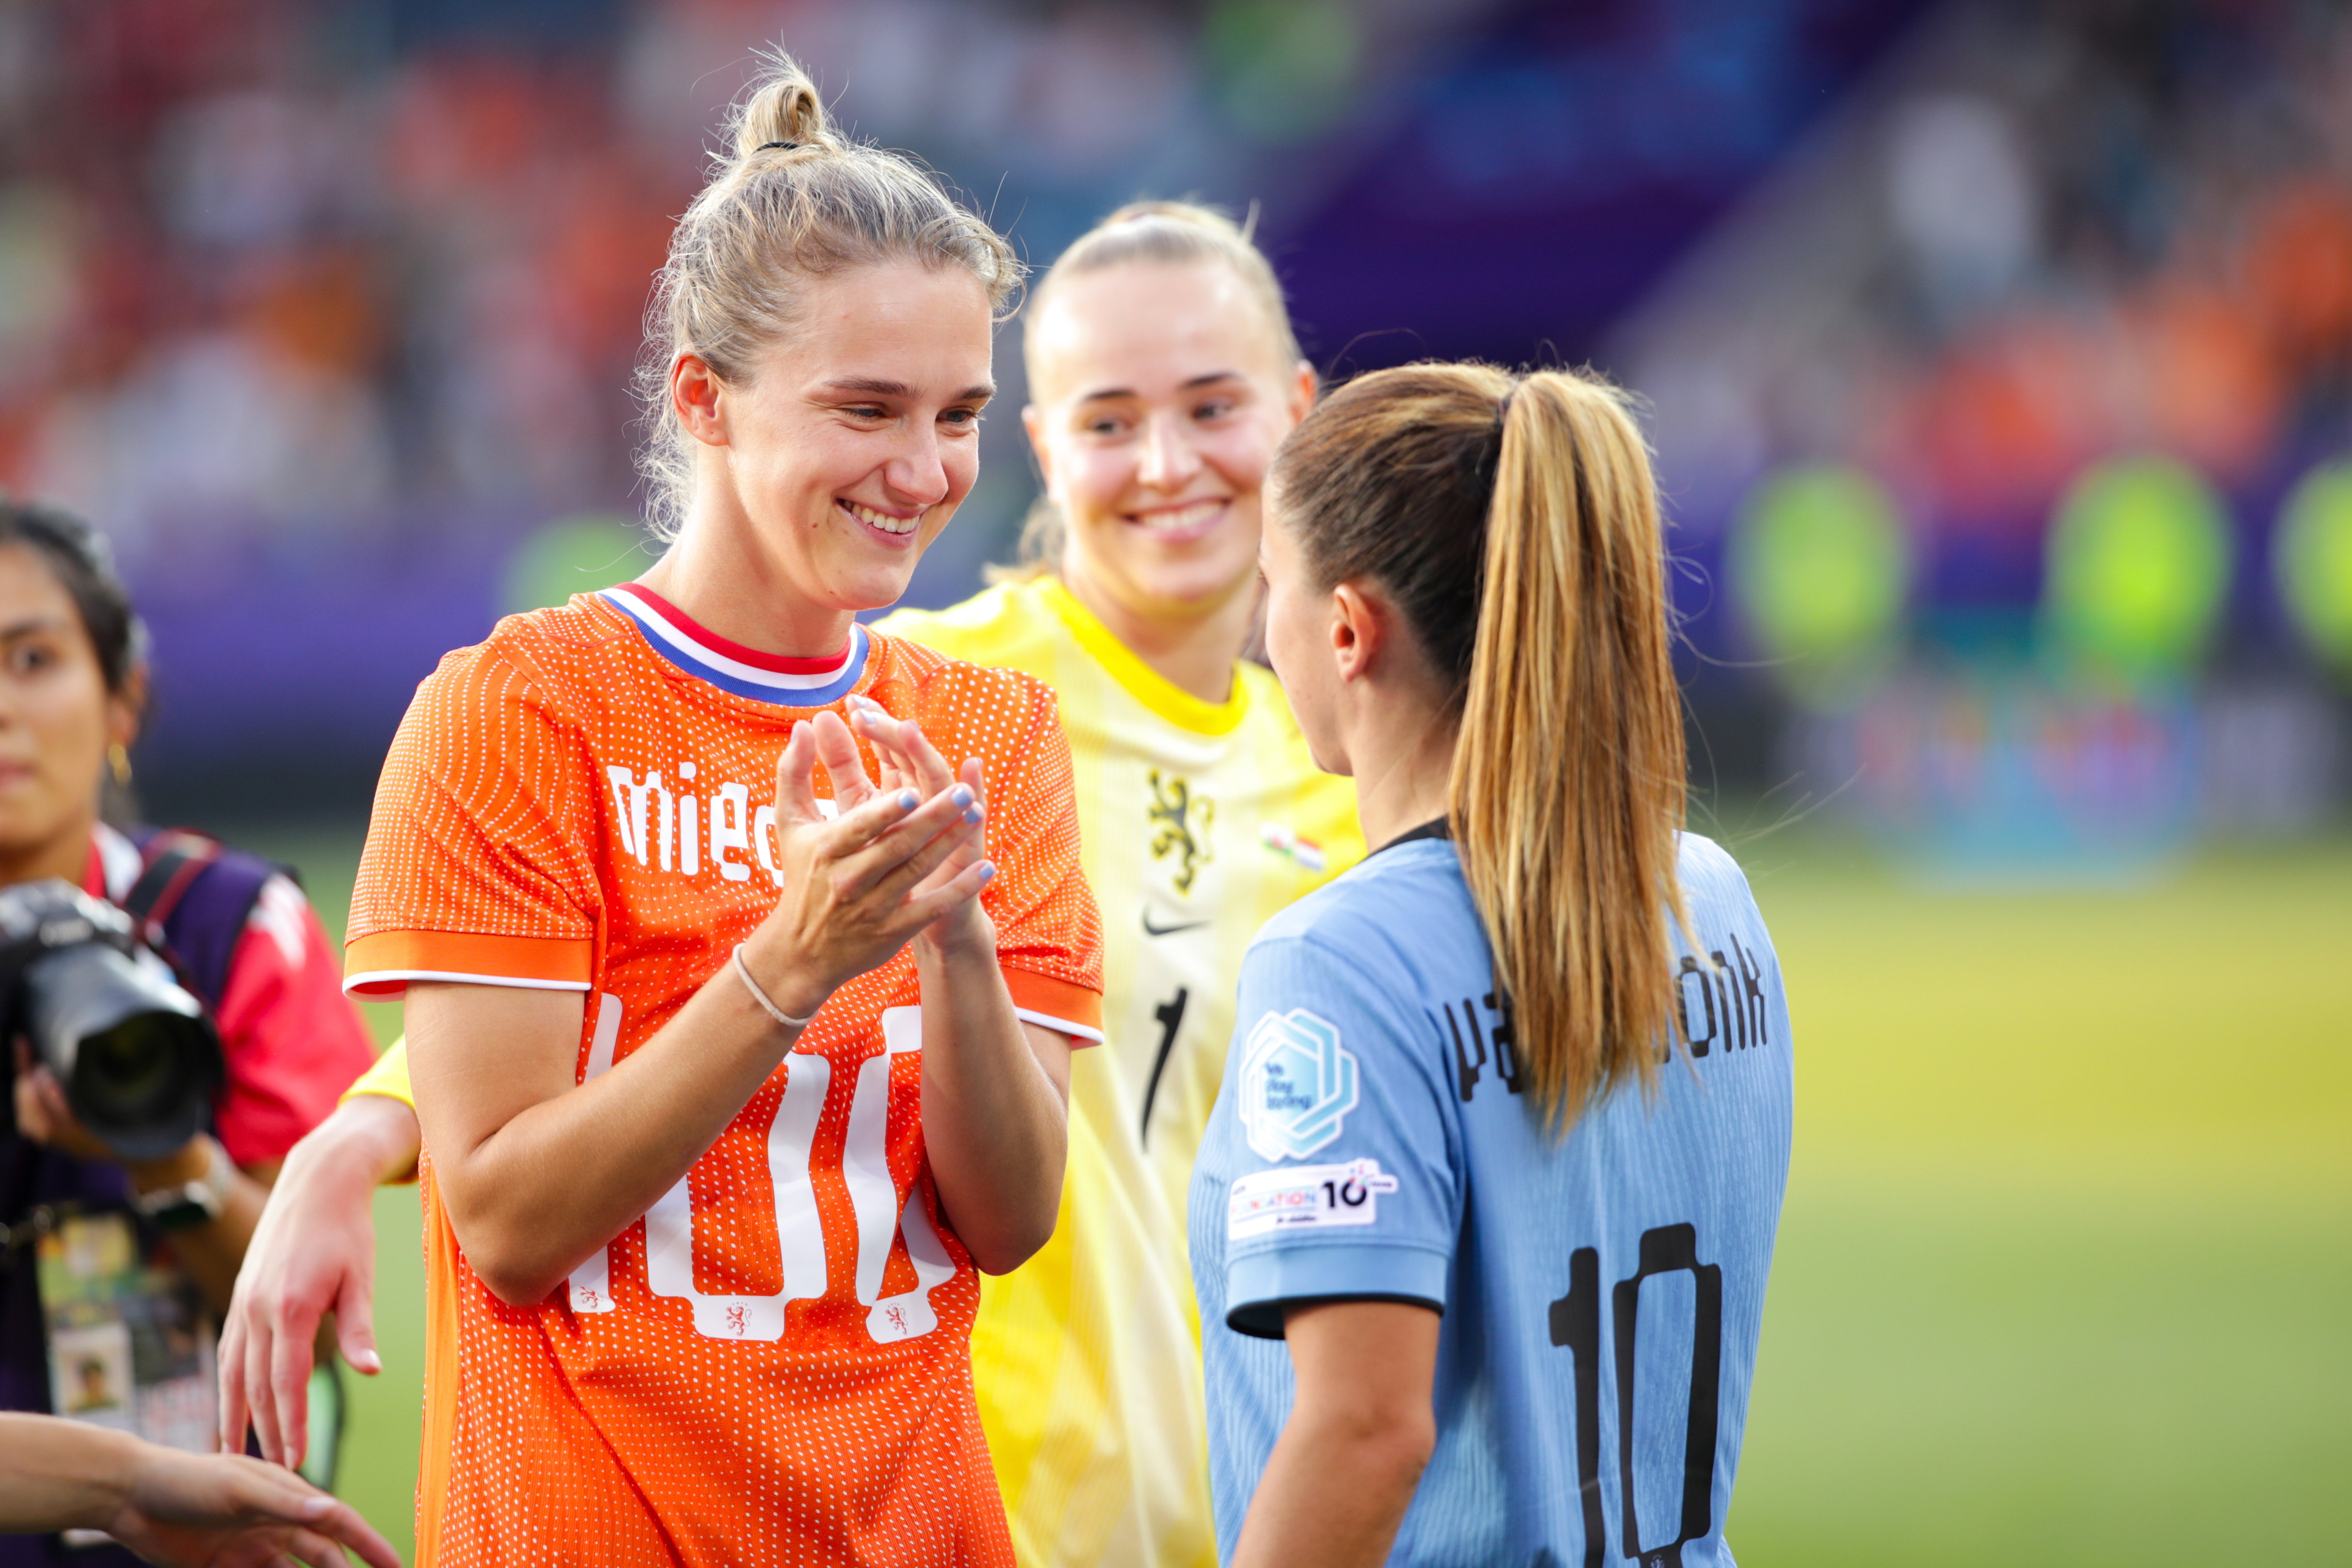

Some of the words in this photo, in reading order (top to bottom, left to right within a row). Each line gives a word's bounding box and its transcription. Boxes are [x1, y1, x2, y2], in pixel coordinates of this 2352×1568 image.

[1140, 986, 1189, 1153] 1
[1654, 933, 1767, 1063] onk
[1321, 1178, 1368, 1207] 10
[1549, 1221, 1722, 1568] 10
